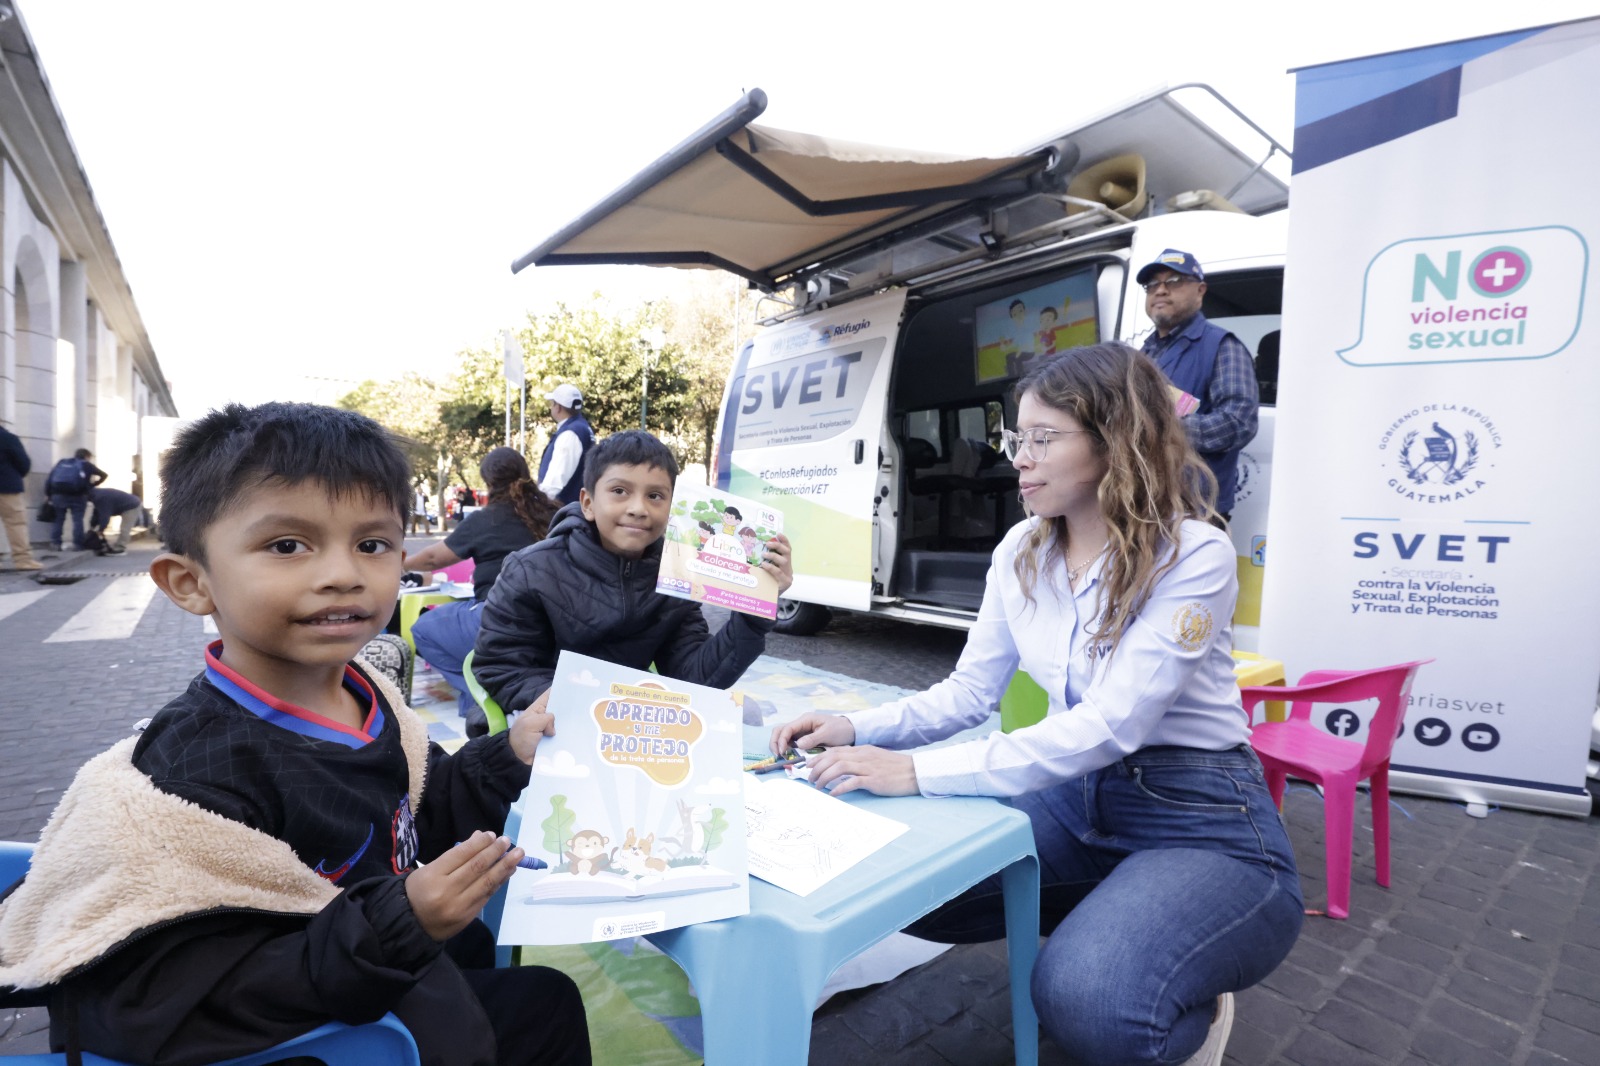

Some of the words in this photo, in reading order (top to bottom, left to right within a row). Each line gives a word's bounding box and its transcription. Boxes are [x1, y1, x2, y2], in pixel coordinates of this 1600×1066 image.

[1411, 303, 1528, 324] violencia
[1408, 320, 1526, 350] sexual
[741, 351, 863, 415] SVET
[779, 426, 799, 434] Violencia
[820, 419, 851, 429] Explotación
[1379, 409, 1419, 450] GOBIERNO
[1423, 404, 1438, 412] DE
[1461, 406, 1502, 449] REPÚBLICA
[790, 434, 812, 442] Personas
[1388, 479, 1486, 503] GUATEMALA
[713, 537, 743, 555] Libro
[1353, 532, 1511, 563] SVET
[704, 555, 744, 571] colorear
[1390, 566, 1462, 580] Secretaría
[1358, 580, 1404, 590] contra
[1408, 579, 1421, 590] la
[1425, 581, 1495, 594] Violencia
[1352, 589, 1404, 603] Sexual,
[1408, 592, 1499, 607] Explotación
[1351, 603, 1360, 613] y
[1364, 602, 1401, 613] Trata
[1405, 603, 1423, 614] de
[1427, 605, 1498, 619] Personas
[613, 685, 623, 694] De
[626, 690, 650, 698] cuento
[665, 695, 688, 703] cuento
[605, 701, 691, 725] APRENDO
[1407, 693, 1505, 715] ariasvet
[600, 733, 689, 756] PROTEJO
[629, 755, 645, 763] trata
